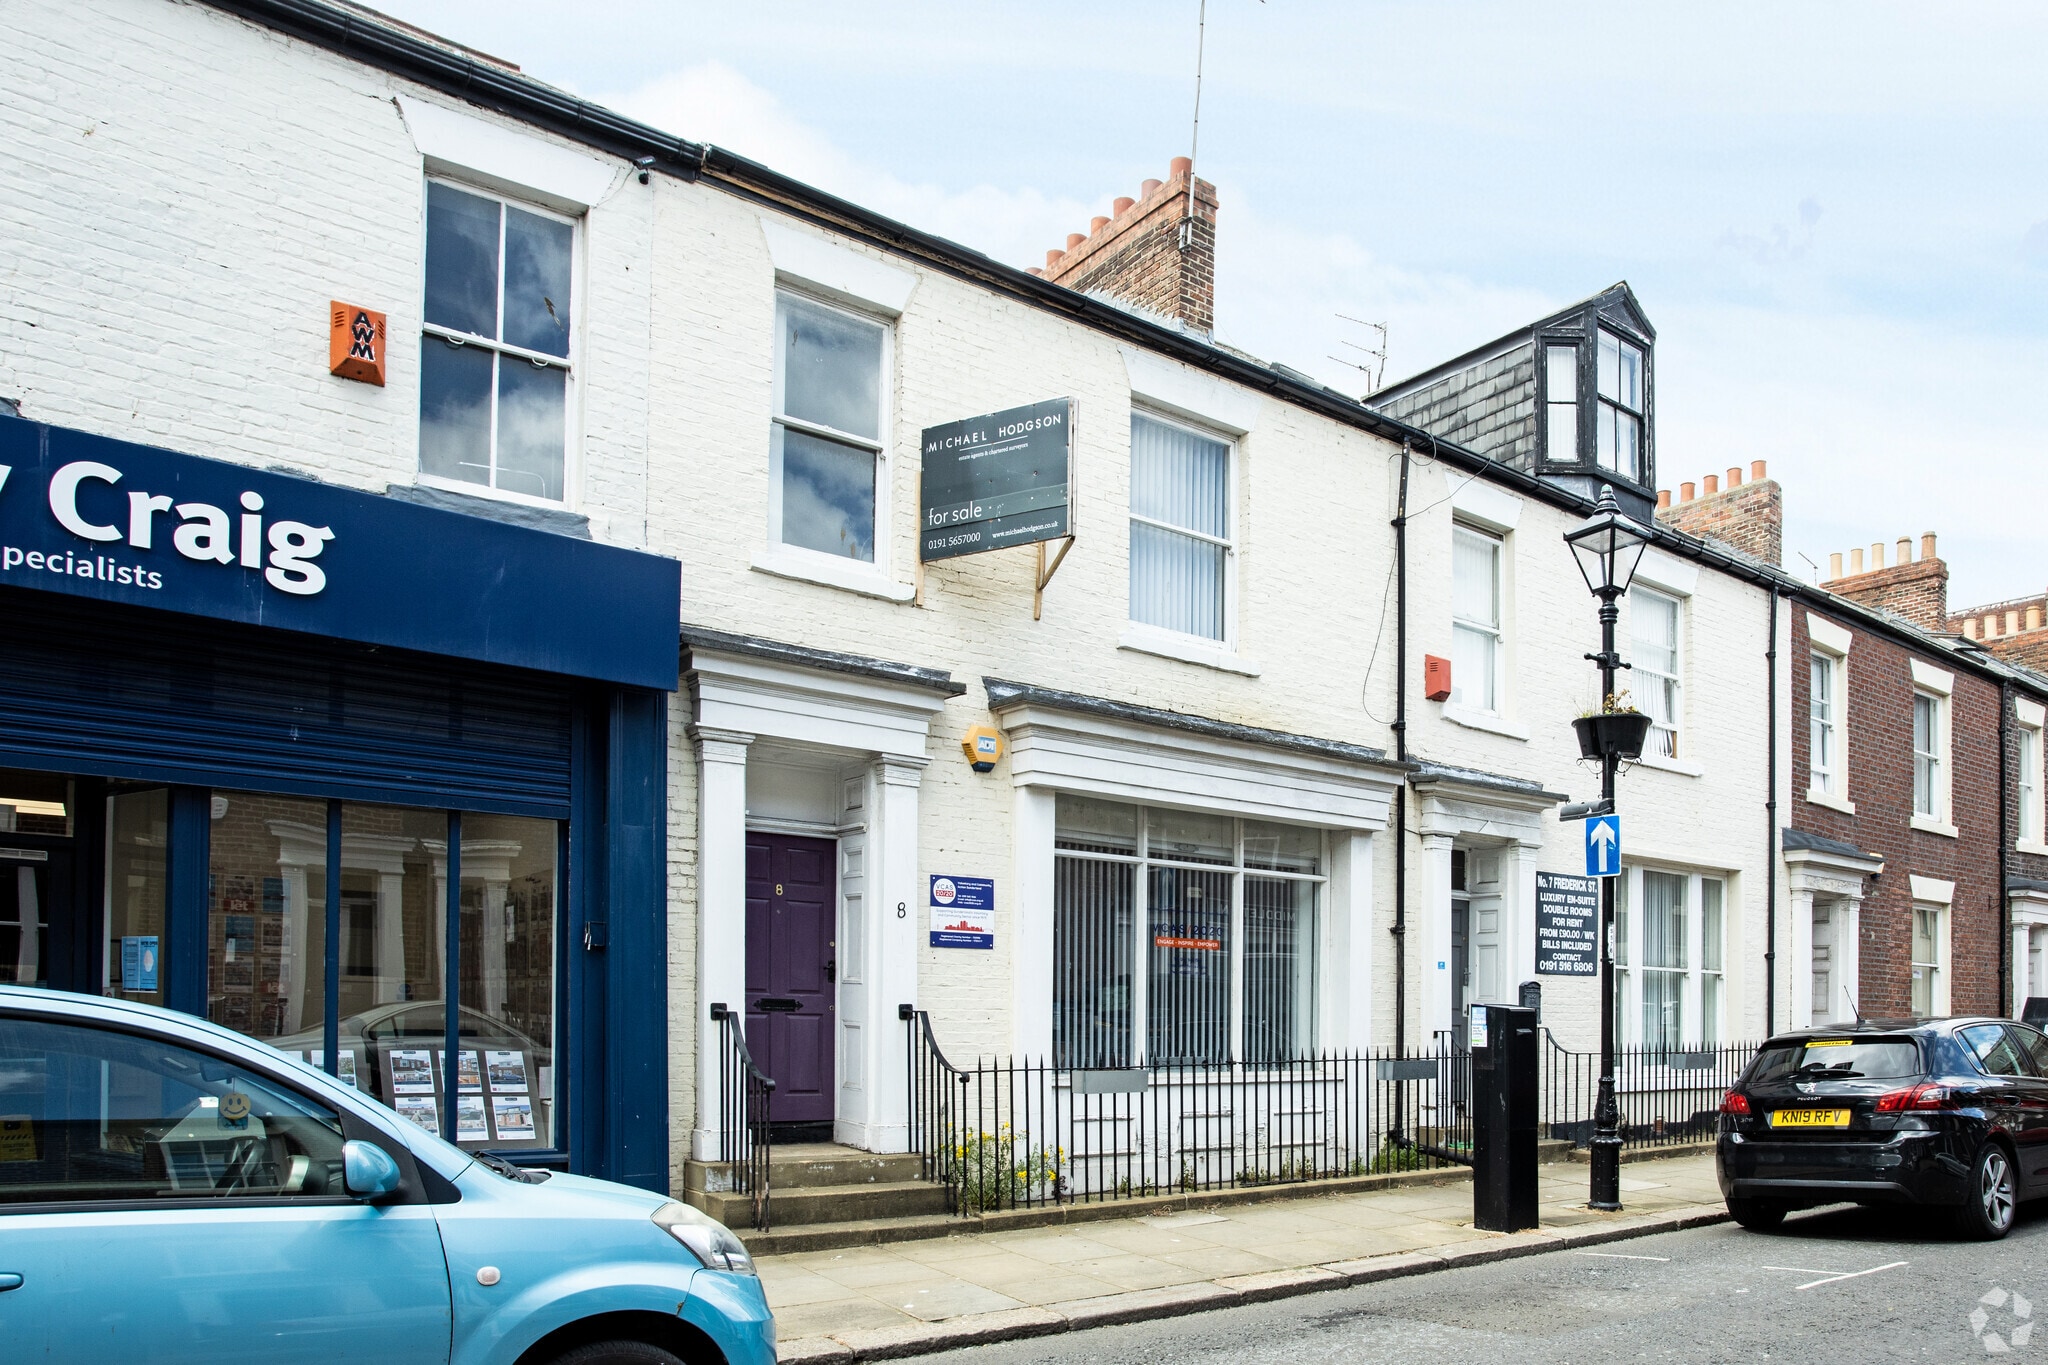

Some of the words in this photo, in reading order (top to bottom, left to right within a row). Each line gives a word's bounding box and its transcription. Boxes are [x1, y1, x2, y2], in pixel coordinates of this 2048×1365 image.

[928, 430, 987, 453] MICHAEL
[999, 413, 1061, 438] HODGSON
[928, 507, 949, 526] for
[952, 500, 983, 522] sale
[49, 460, 336, 595] Craig
[928, 538, 947, 550] 0191
[948, 531, 981, 547] 5657000
[991, 520, 1059, 539] www.michaelhodgson.co.uk
[0, 545, 164, 590] pecialists
[978, 740, 996, 751] ADT
[775, 883, 784, 896] 8
[1537, 875, 1548, 888] No.
[1548, 877, 1554, 889] 7
[1553, 877, 1587, 892] FREDERICK
[1587, 881, 1598, 893] ST.
[1540, 892, 1566, 903] LUXURY
[1567, 894, 1596, 906] EN-SUITE
[896, 902, 906, 919] 8
[1543, 904, 1569, 915] DOUBLE
[1569, 907, 1593, 917] ROOMS
[1552, 917, 1566, 927] FOR
[1566, 918, 1584, 928] RENT
[1540, 928, 1558, 938] FROM
[1558, 929, 1580, 939] £90.00
[1542, 940, 1560, 949] BILLS
[1561, 941, 1592, 951] INCLUDED
[1552, 952, 1582, 961] CONTACT
[1540, 960, 1557, 971] 0191
[1558, 961, 1572, 971] 516
[1781, 1110, 1811, 1123] KN19
[1814, 1110, 1842, 1123] RFV
